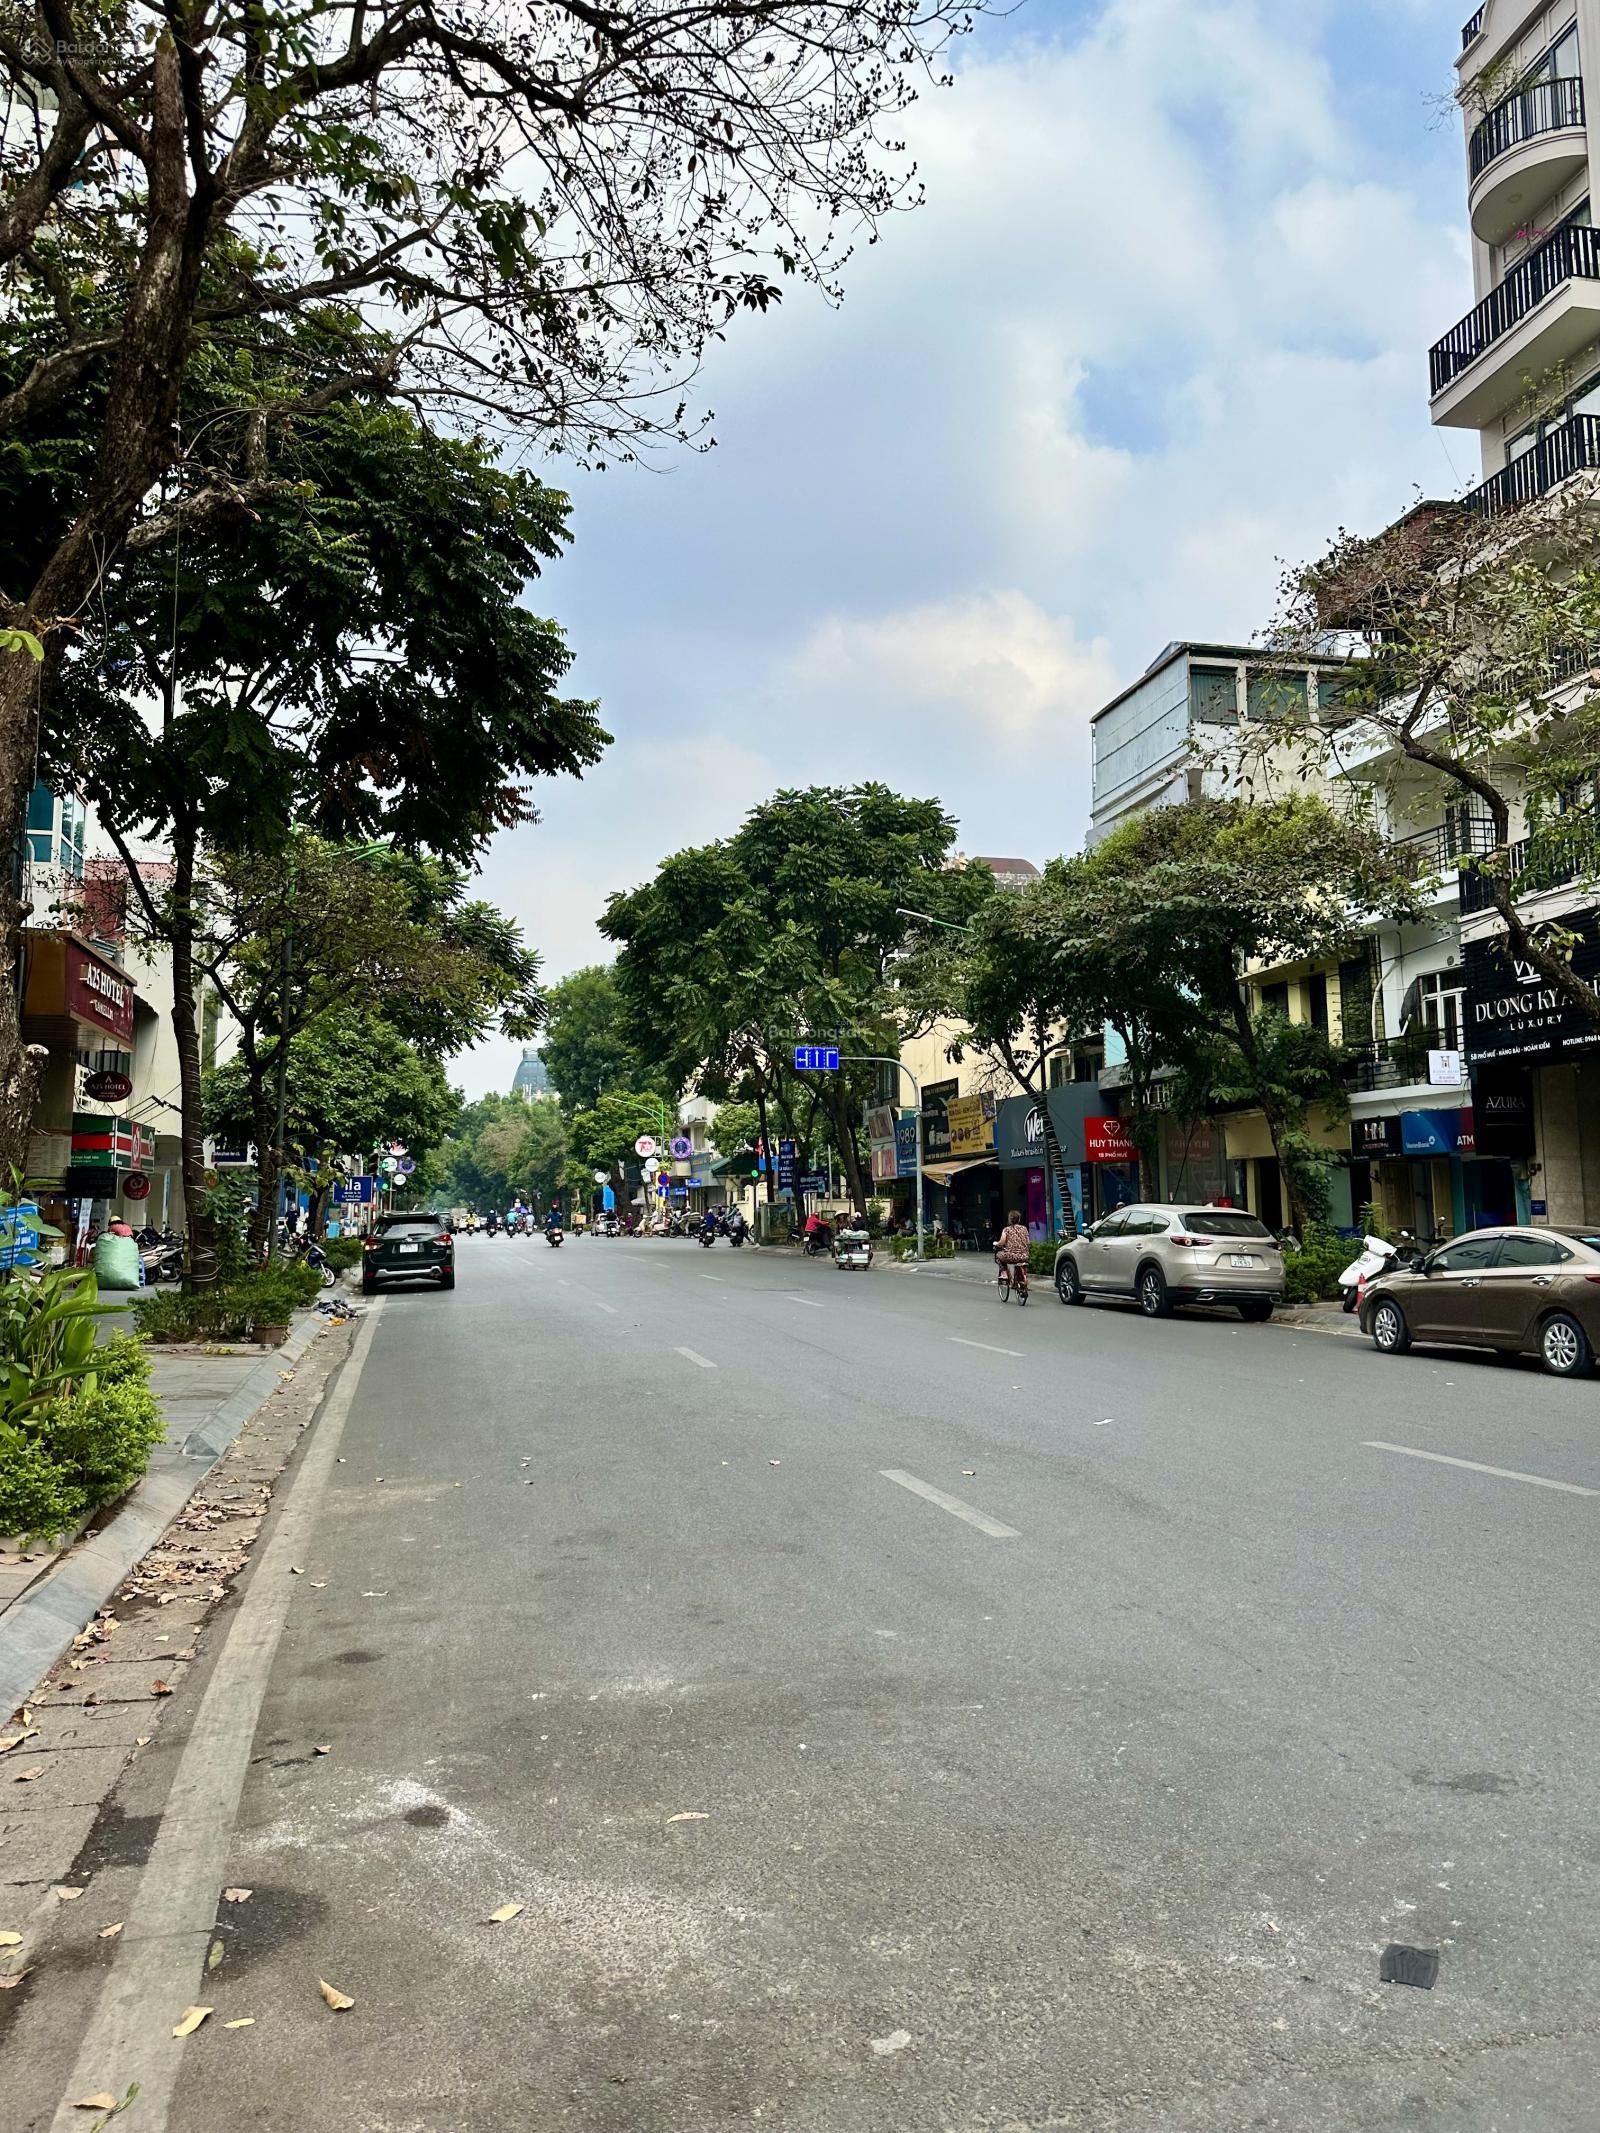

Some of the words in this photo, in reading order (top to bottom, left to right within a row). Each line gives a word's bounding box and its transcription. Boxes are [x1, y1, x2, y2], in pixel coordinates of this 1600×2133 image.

[100, 974, 125, 1007] HOTEL
[1510, 1014, 1562, 1031] LUXURY
[897, 1127, 915, 1144] 1989
[1089, 1139, 1105, 1148] HUY
[1456, 1135, 1474, 1146] ATM
